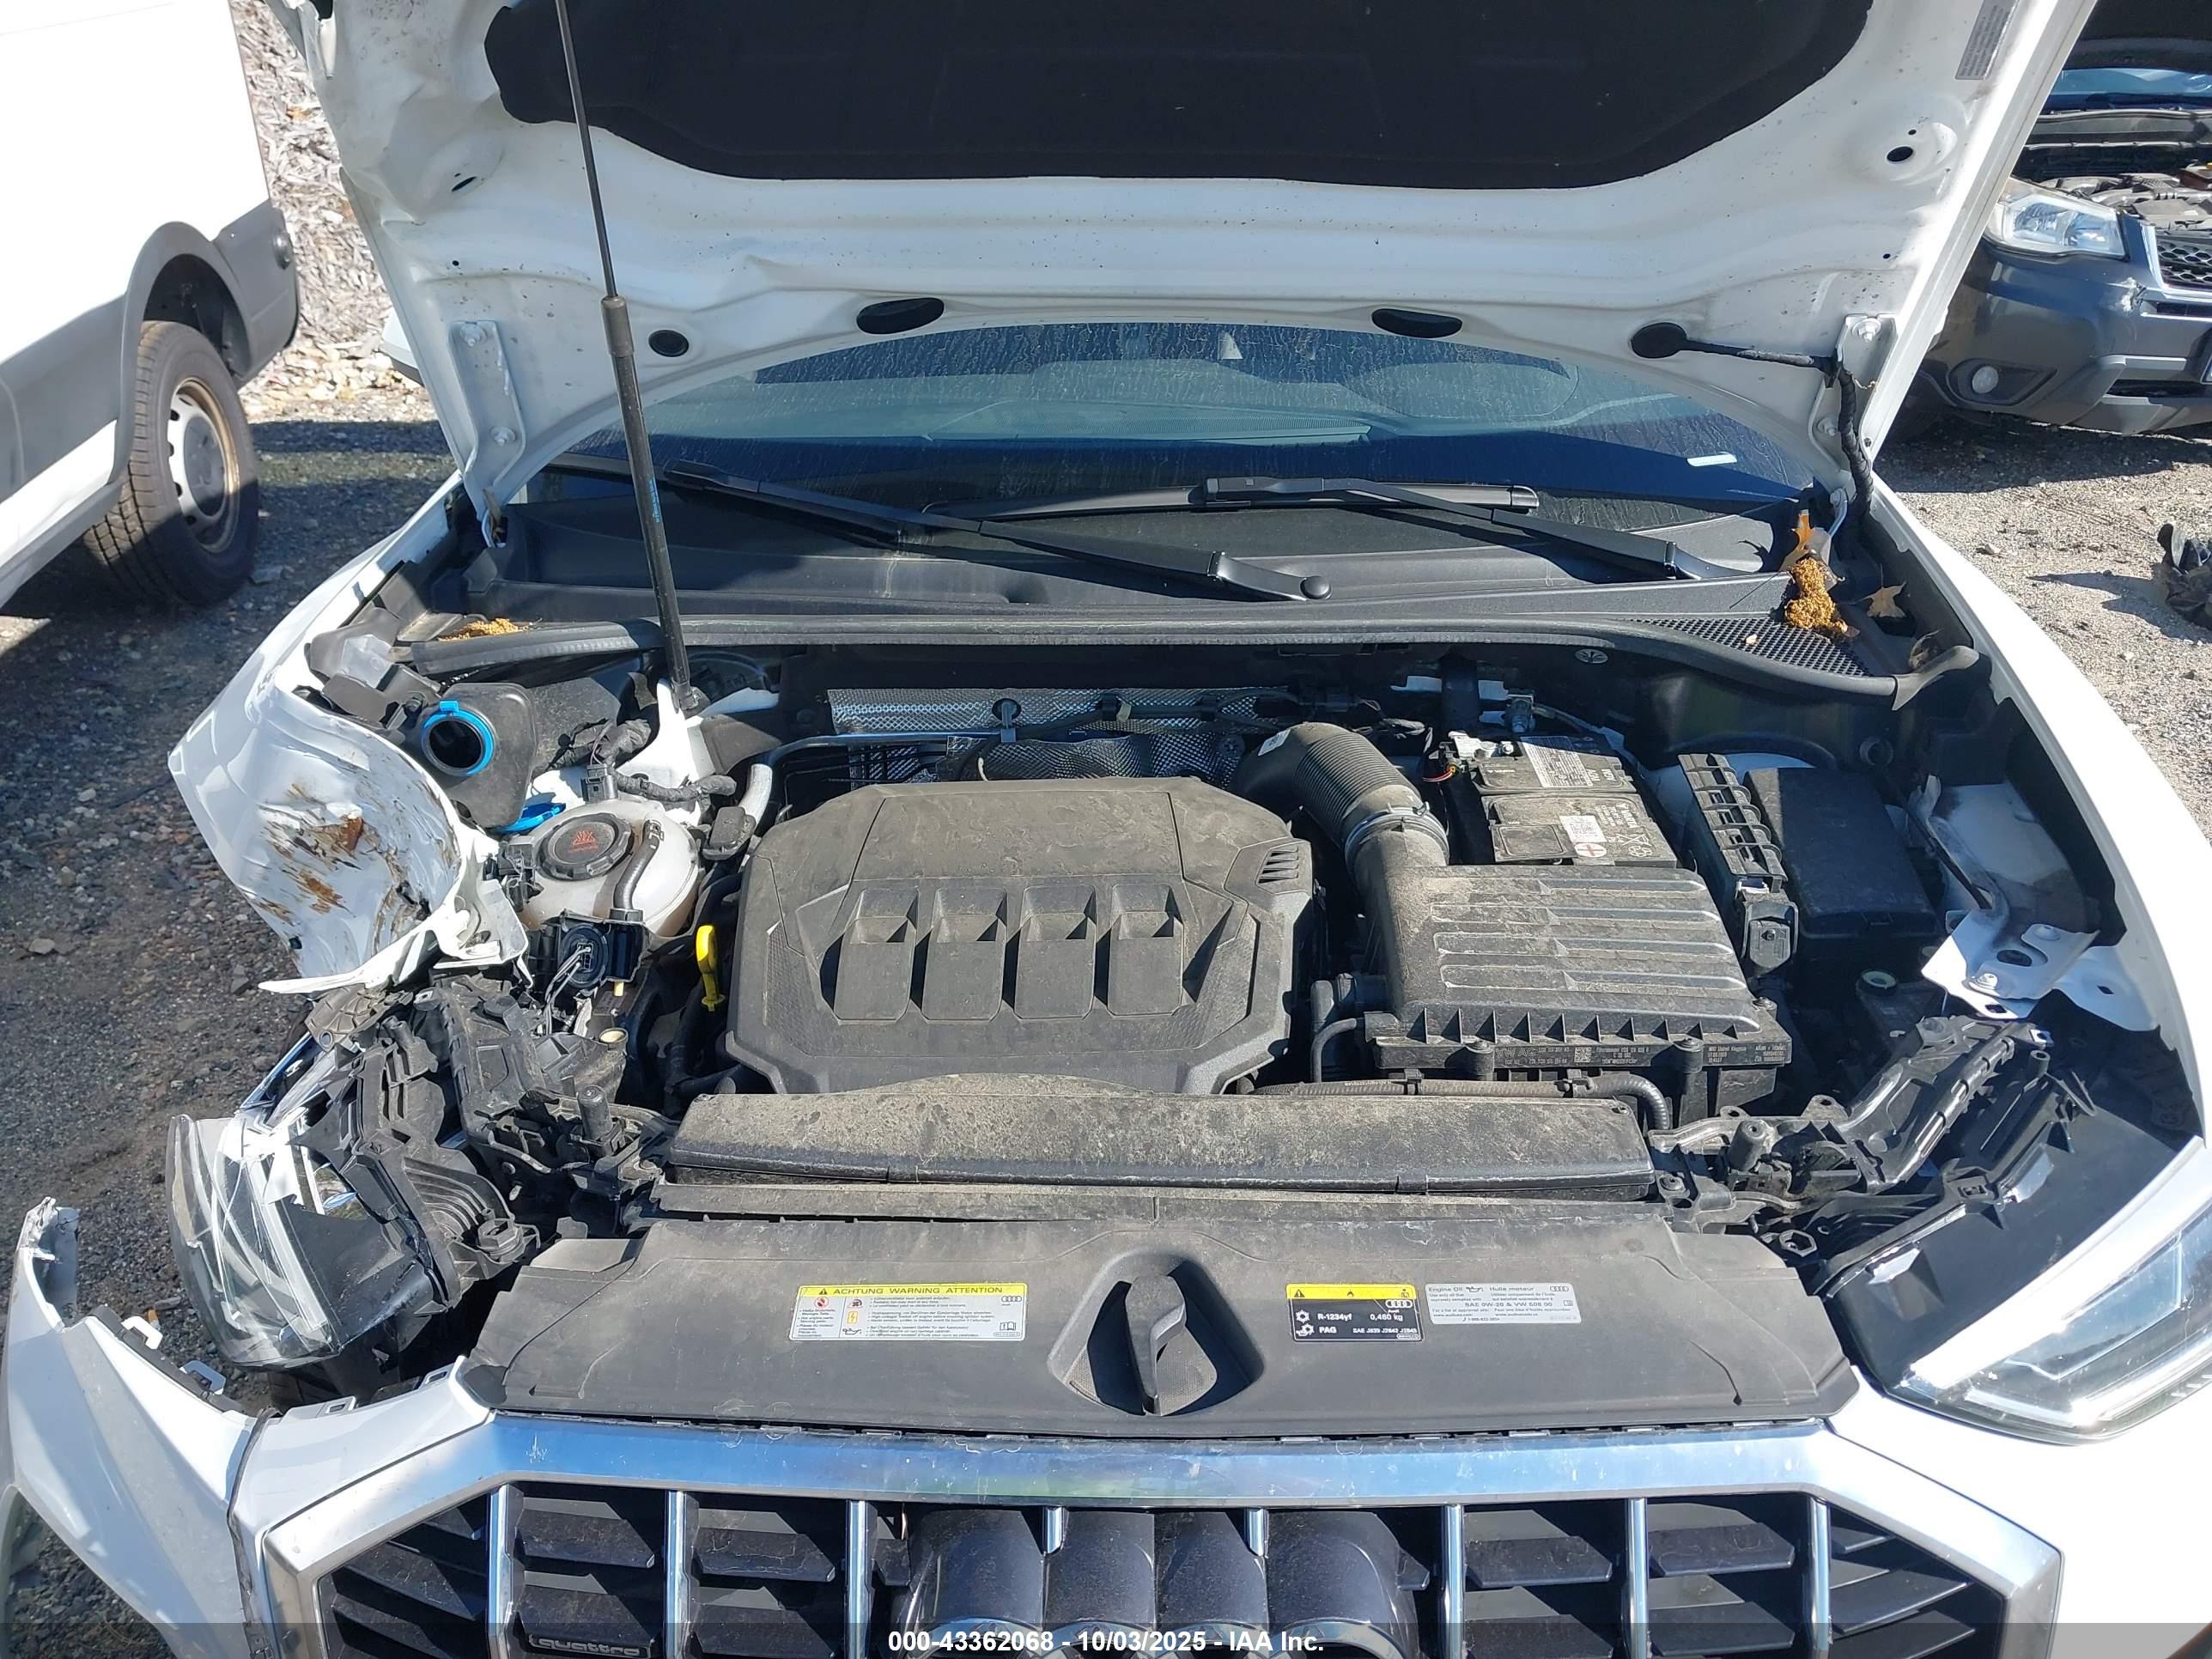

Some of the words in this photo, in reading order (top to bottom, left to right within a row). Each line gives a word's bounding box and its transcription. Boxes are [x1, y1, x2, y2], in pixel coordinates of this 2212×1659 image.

[1317, 1313, 1352, 1322] R-1234yf
[1393, 1313, 1403, 1322] kg
[538, 1638, 641, 1656] quattro
